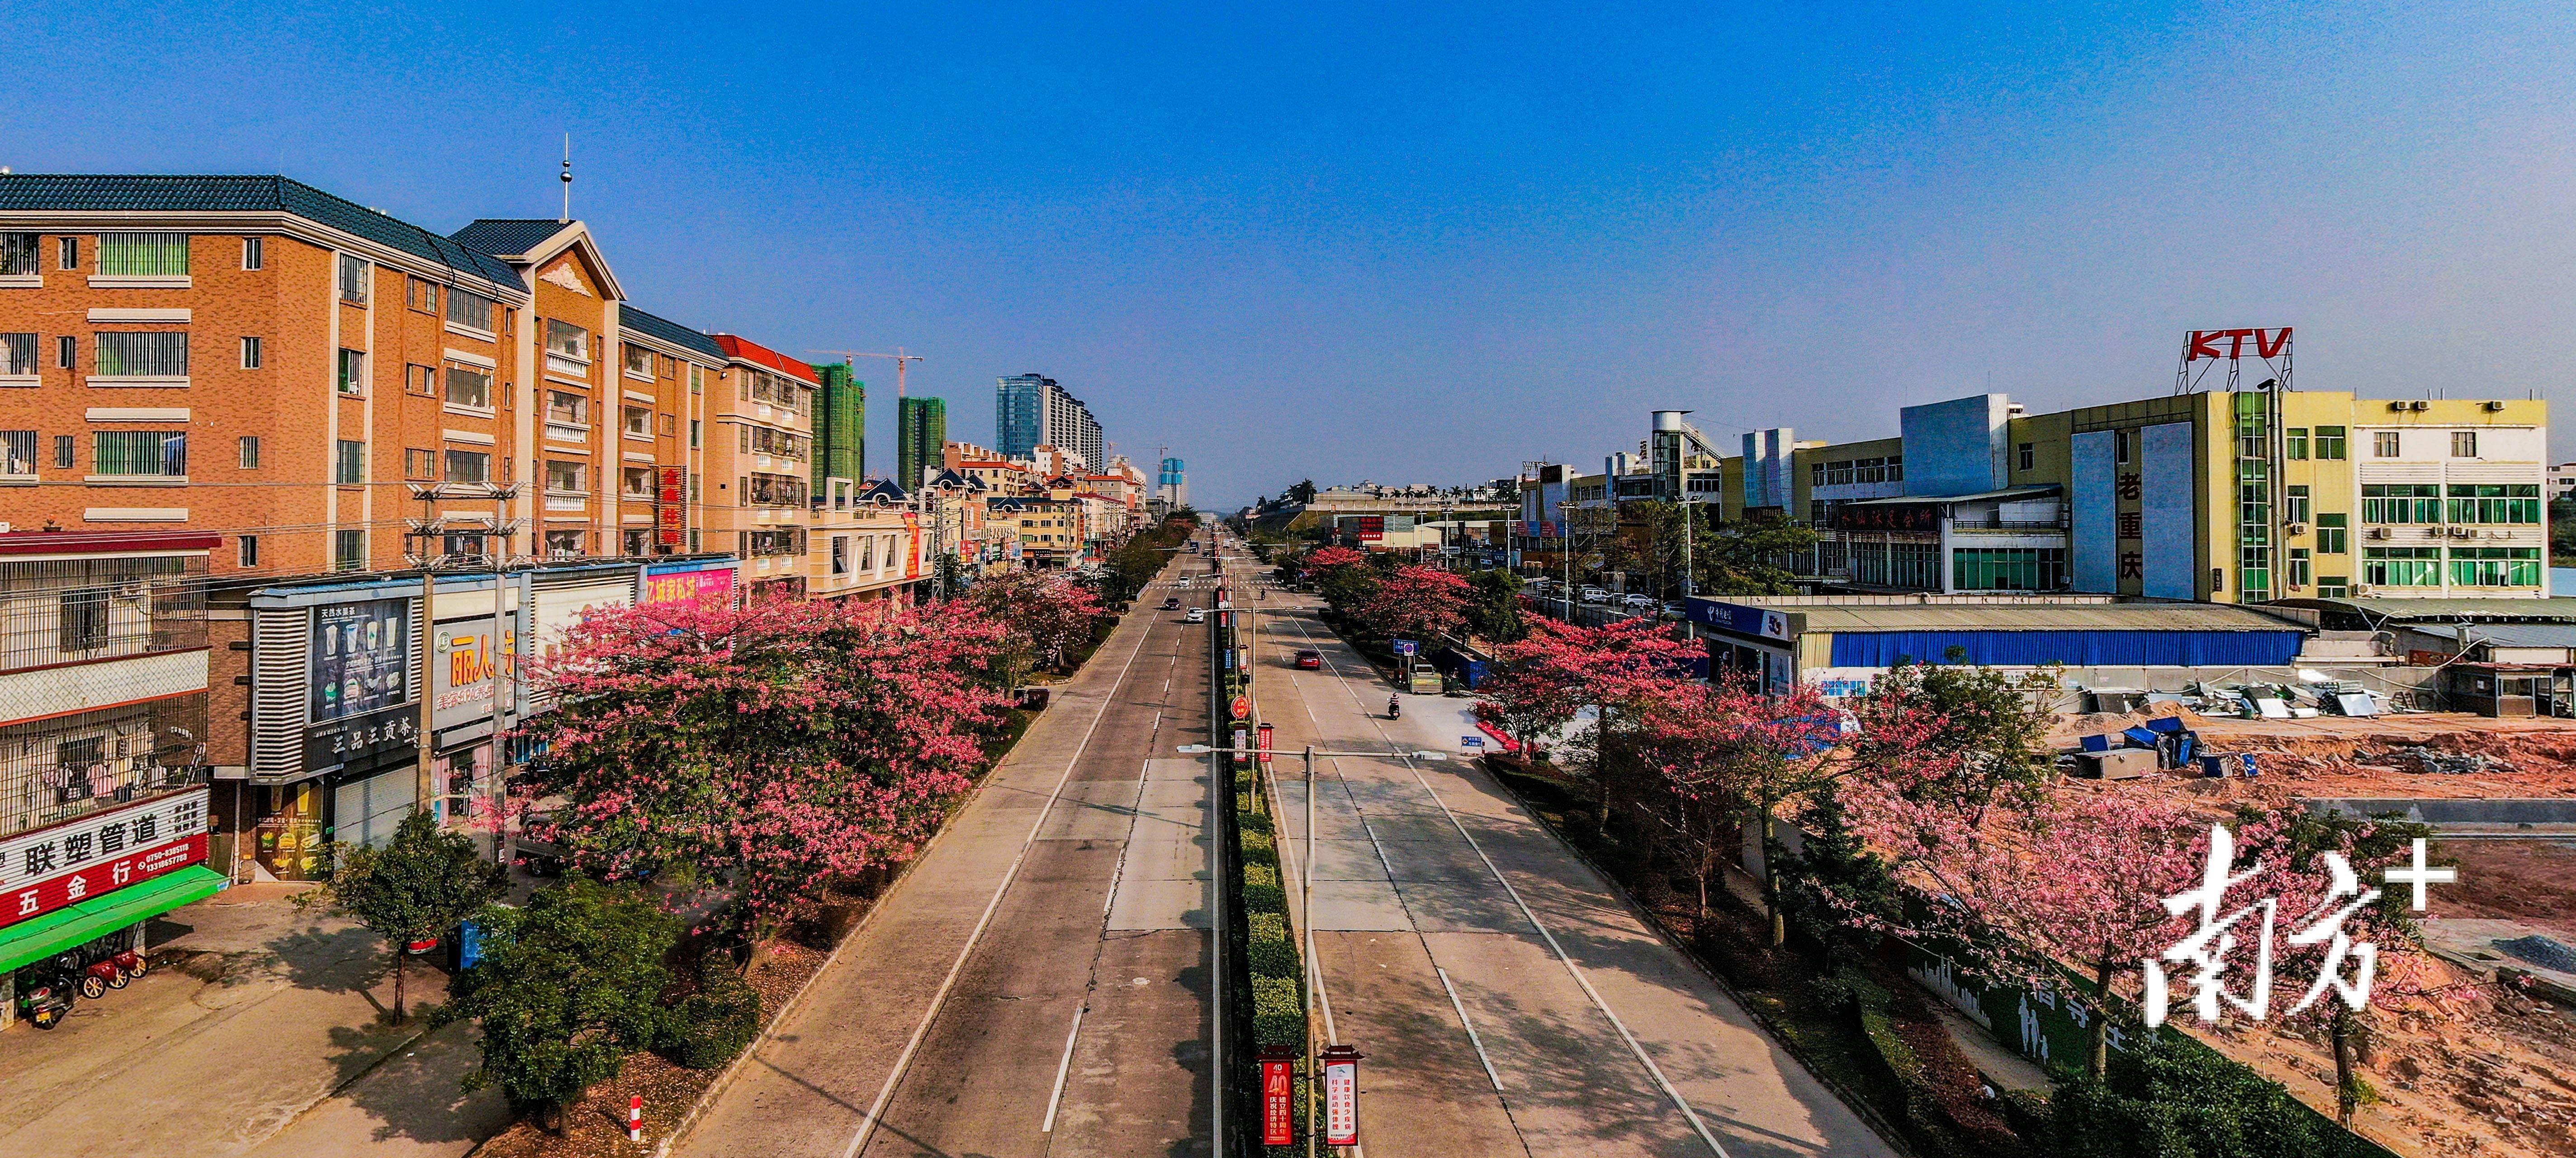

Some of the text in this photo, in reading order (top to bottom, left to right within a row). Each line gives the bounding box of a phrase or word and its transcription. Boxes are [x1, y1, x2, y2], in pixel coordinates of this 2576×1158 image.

[2189, 327, 2293, 361] KTV
[2118, 472, 2143, 579] 老重庆
[25, 813, 158, 876] 联塑管道
[18, 860, 132, 916] 五金行
[1269, 1075, 1288, 1096] 40
